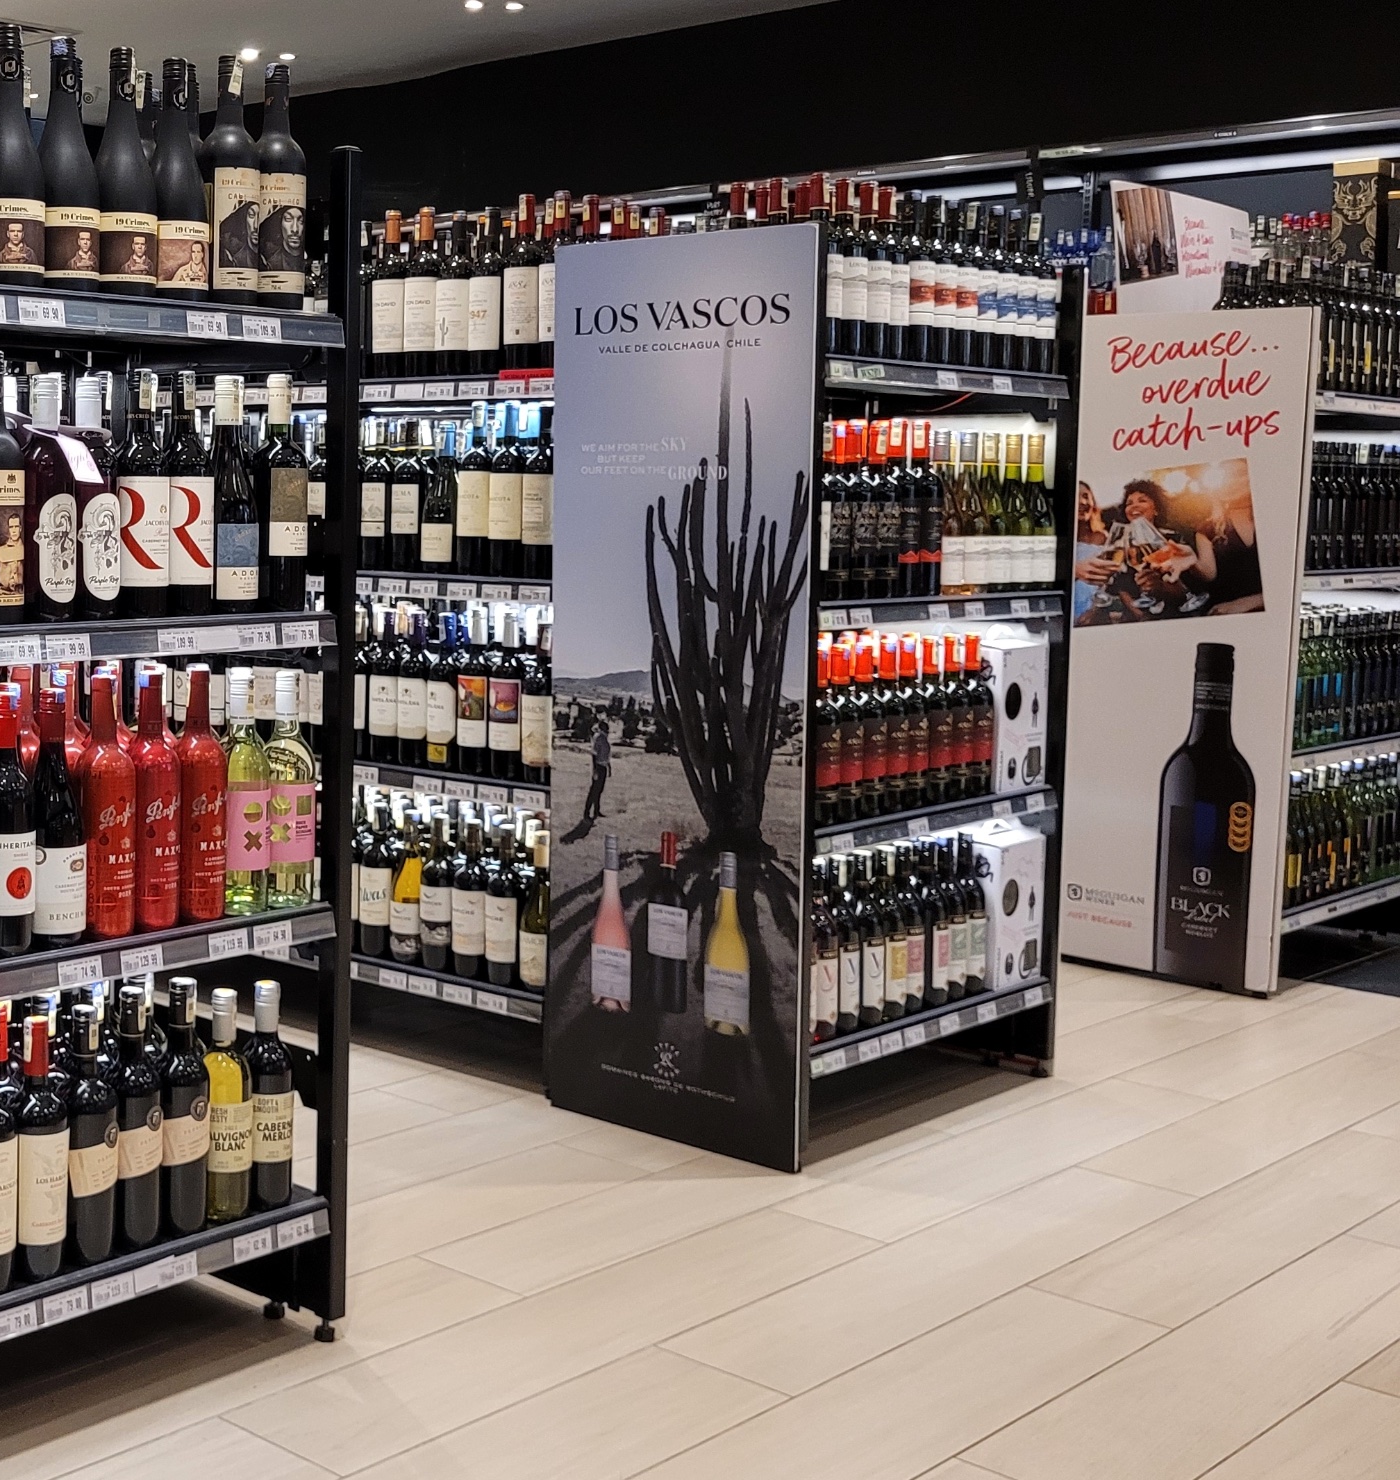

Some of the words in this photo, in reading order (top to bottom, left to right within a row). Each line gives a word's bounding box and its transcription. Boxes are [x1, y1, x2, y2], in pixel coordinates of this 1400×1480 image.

[60, 213, 68, 221] 19
[115, 218, 123, 226] 19
[174, 226, 182, 234] 19
[42, 307, 60, 319] 69.90
[574, 303, 639, 336] LOS
[647, 293, 791, 331] VASCOS
[598, 345, 631, 354] VALLE
[634, 344, 648, 352] DE
[651, 340, 720, 352] COLCHAGUA
[726, 338, 761, 348] CHILE
[1141, 360, 1271, 405] overdue
[1112, 407, 1281, 451] catch-ups
[581, 443, 596, 452] WE
[598, 443, 615, 452] AIM
[617, 443, 636, 452] FOR
[661, 437, 687, 451] SKY
[598, 455, 617, 463] BUT
[619, 455, 646, 463] KEEP
[581, 466, 602, 475] OUR
[604, 466, 629, 475] FEET
[630, 466, 645, 474] ON
[648, 465, 667, 475] THE
[668, 465, 728, 480] GROUND
[1170, 896, 1231, 919] BLACK
[81, 963, 98, 979] 74.90
[214, 1140, 246, 1152] BLANC
